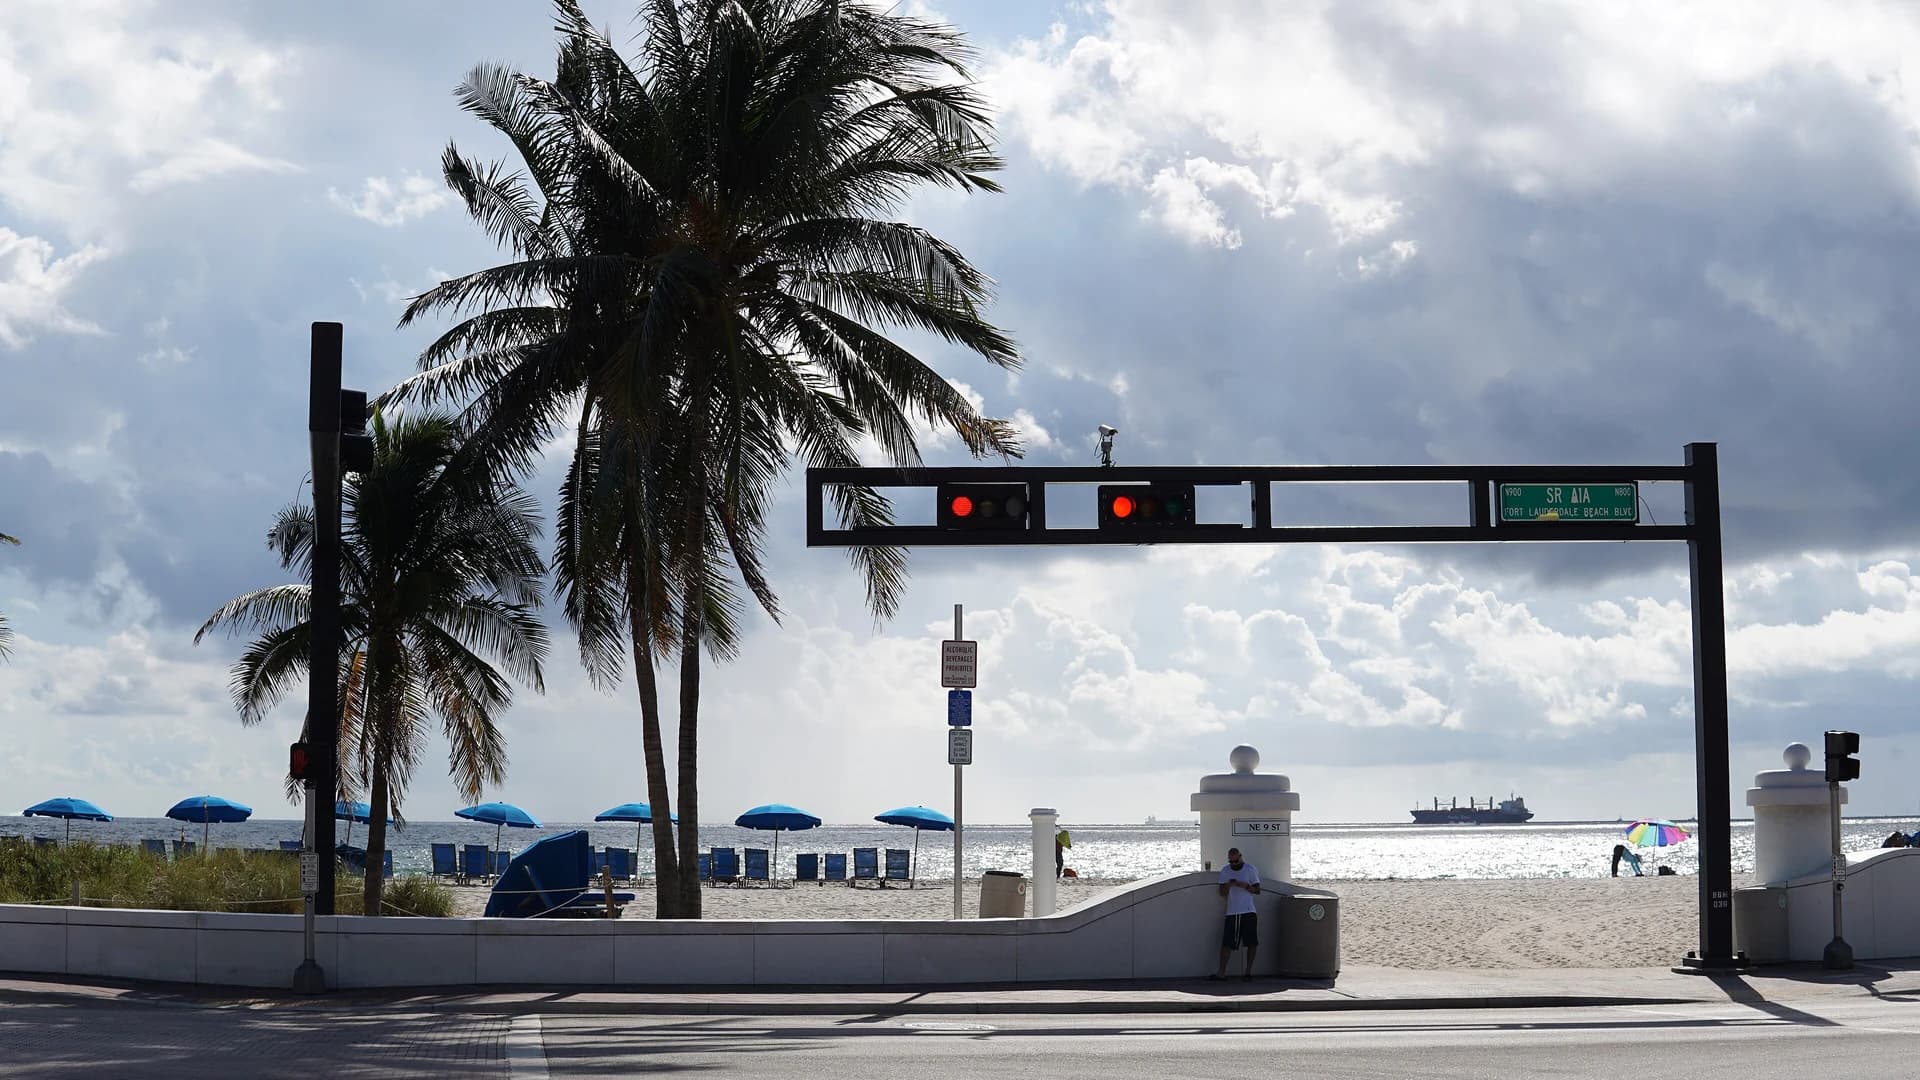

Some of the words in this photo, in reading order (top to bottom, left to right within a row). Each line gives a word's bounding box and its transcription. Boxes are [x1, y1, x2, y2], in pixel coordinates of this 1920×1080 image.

[1505, 488, 1521, 496] N900
[1546, 487, 1562, 503] SR
[1504, 507, 1523, 516] FORT
[1584, 507, 1609, 517] BEACH
